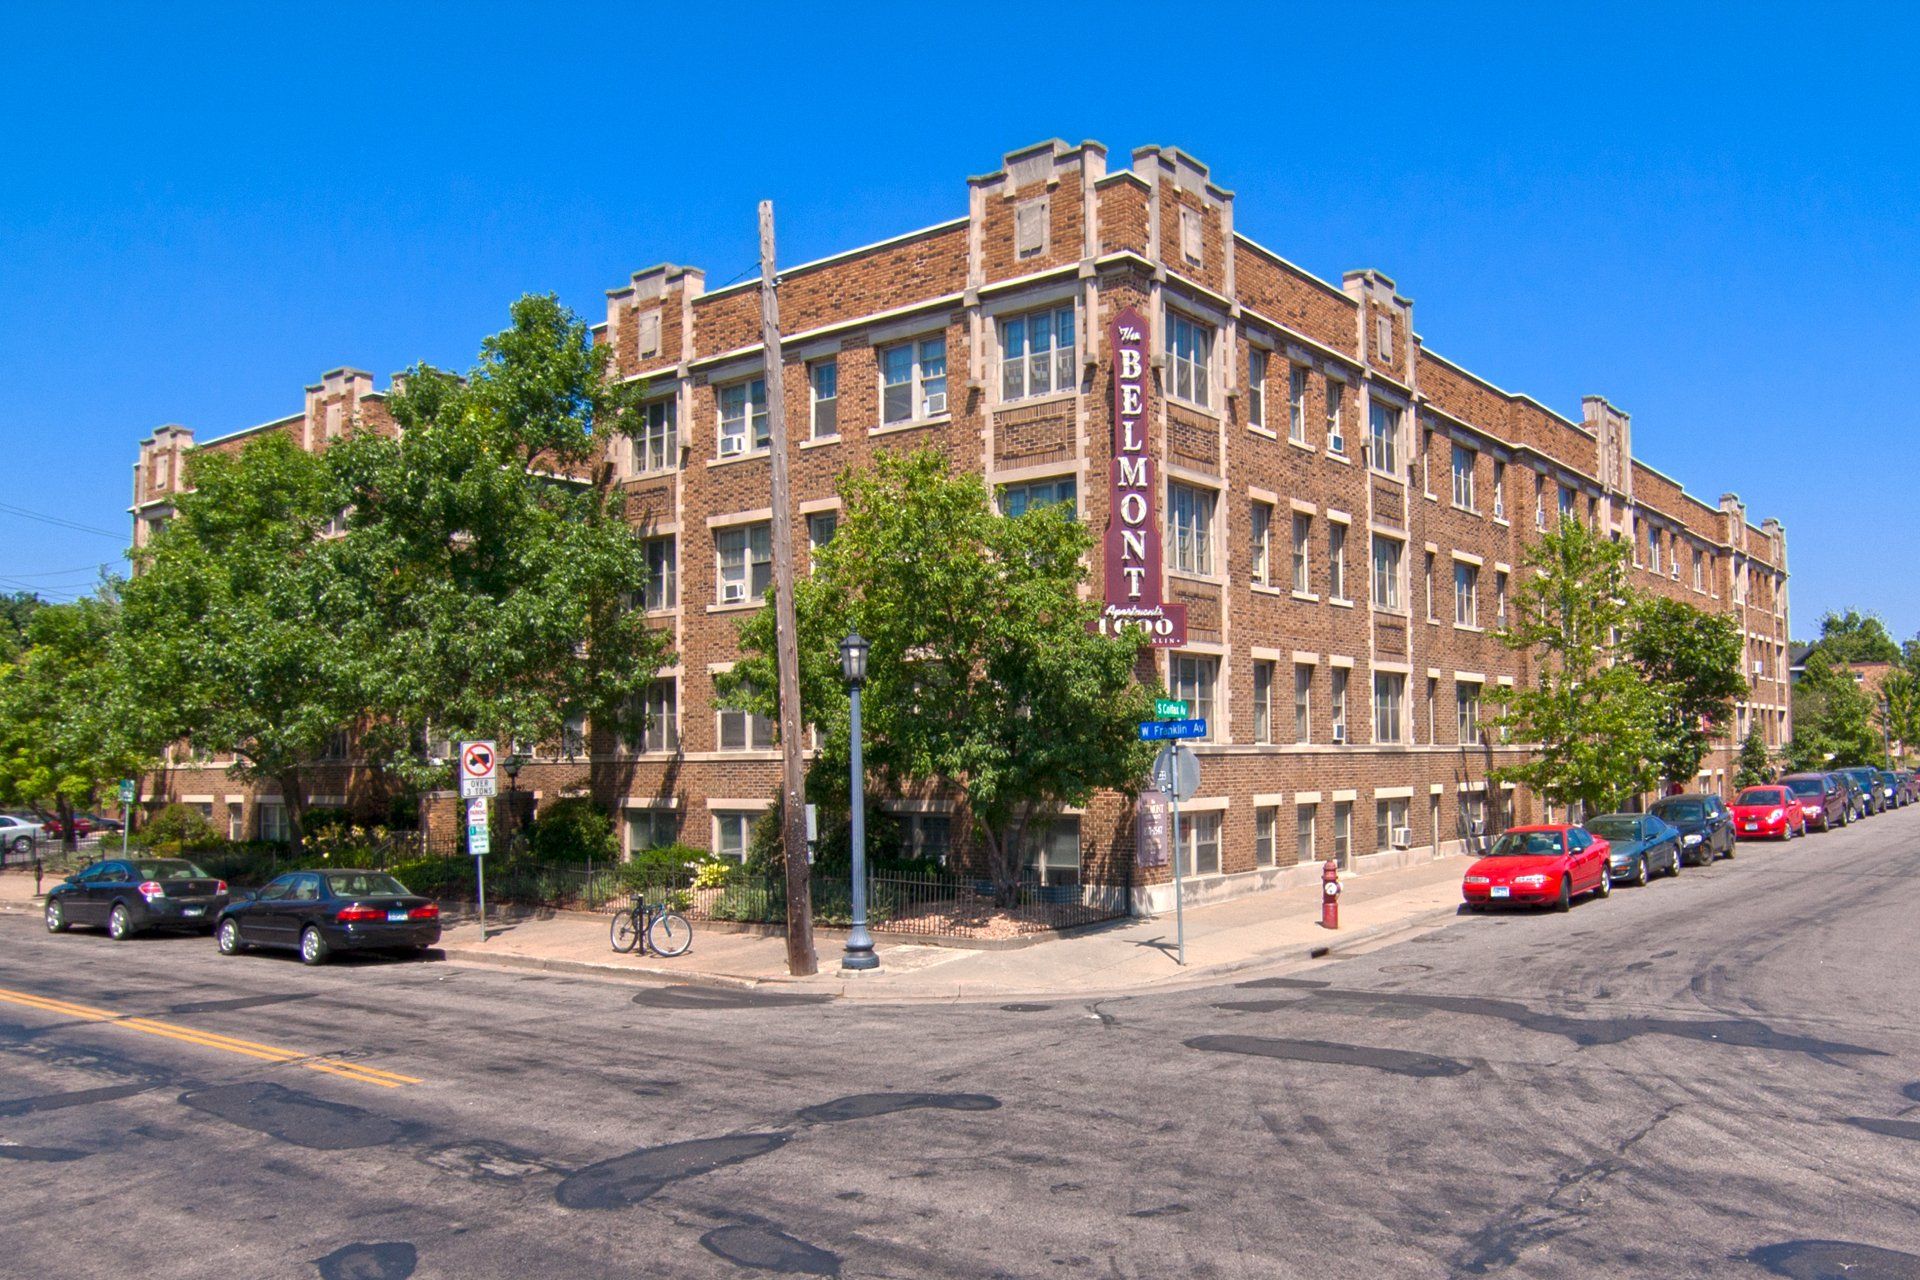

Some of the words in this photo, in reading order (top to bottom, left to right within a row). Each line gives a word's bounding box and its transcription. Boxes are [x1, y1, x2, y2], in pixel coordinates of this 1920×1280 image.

[1118, 326, 1141, 341] The
[1117, 349, 1148, 597] BELMONT
[1105, 604, 1164, 619] Apartments
[1157, 703, 1162, 714] S
[1141, 726, 1149, 737] W
[1154, 725, 1188, 735] Franklin
[1193, 722, 1204, 733] Av
[466, 788, 471, 796] 3
[475, 787, 493, 795] TONS
[470, 780, 489, 788] OVER
